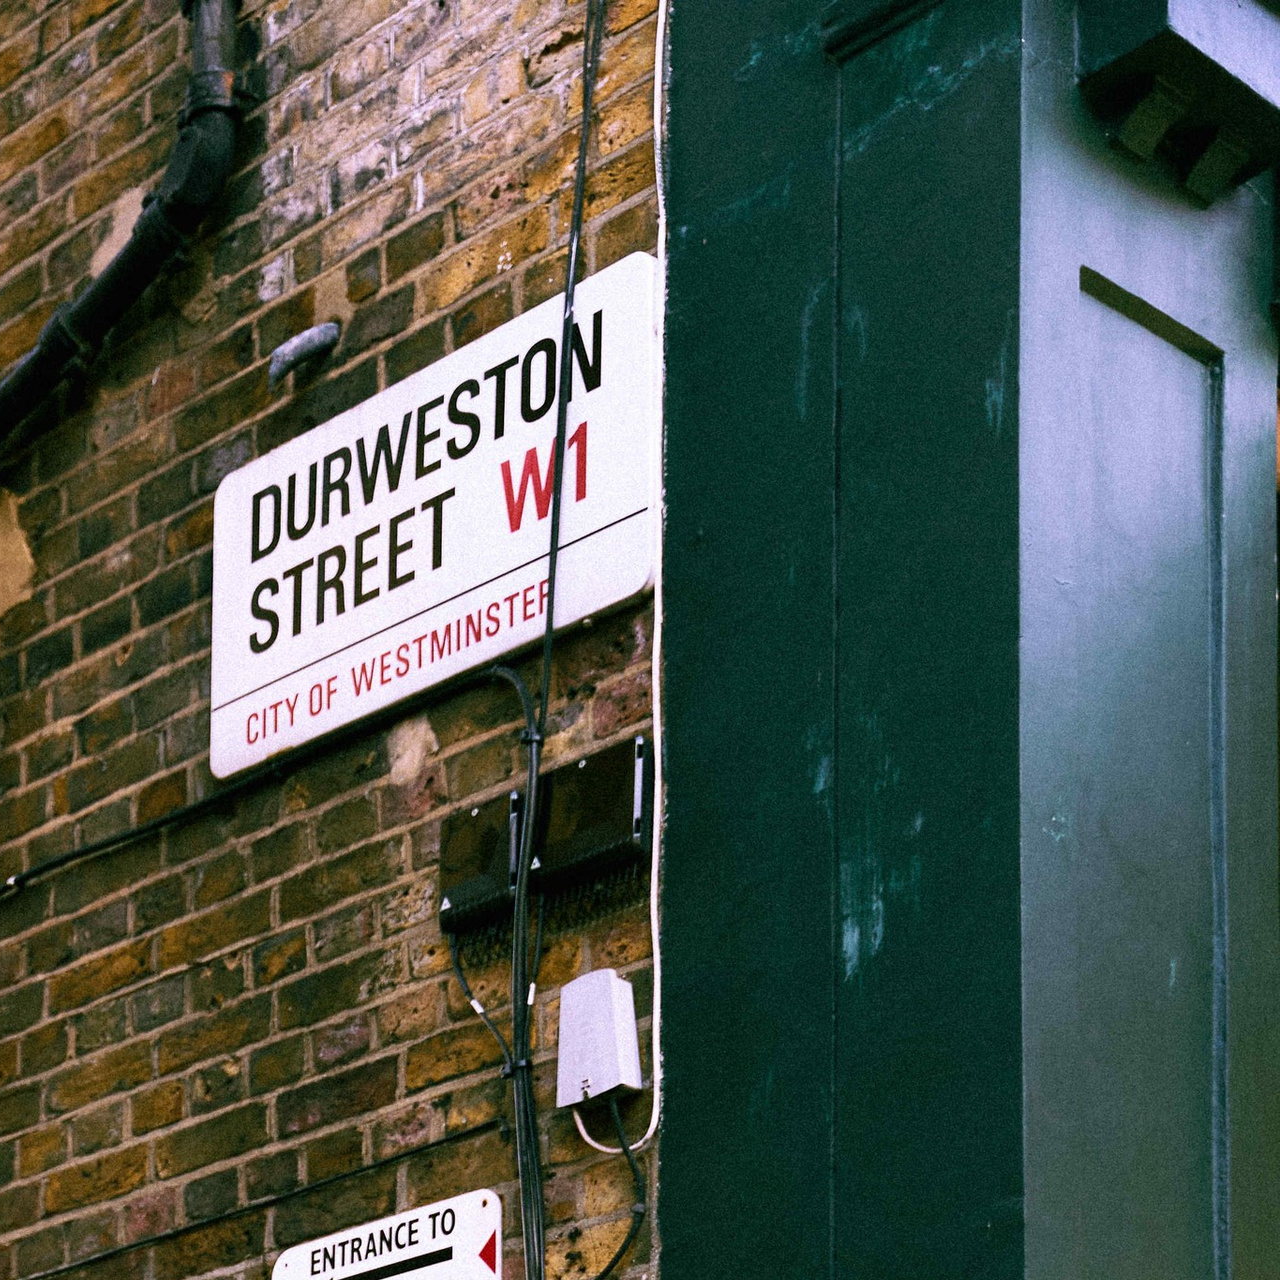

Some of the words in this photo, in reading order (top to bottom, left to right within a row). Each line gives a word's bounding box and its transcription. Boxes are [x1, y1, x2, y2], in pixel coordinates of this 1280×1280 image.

[251, 309, 603, 563] DURWESTON
[249, 487, 456, 654] STREET
[501, 421, 588, 533] W1
[246, 692, 297, 745] CITY
[308, 675, 339, 717] OF
[311, 1219, 418, 1275] ENTRANCE
[428, 1208, 456, 1239] TO
